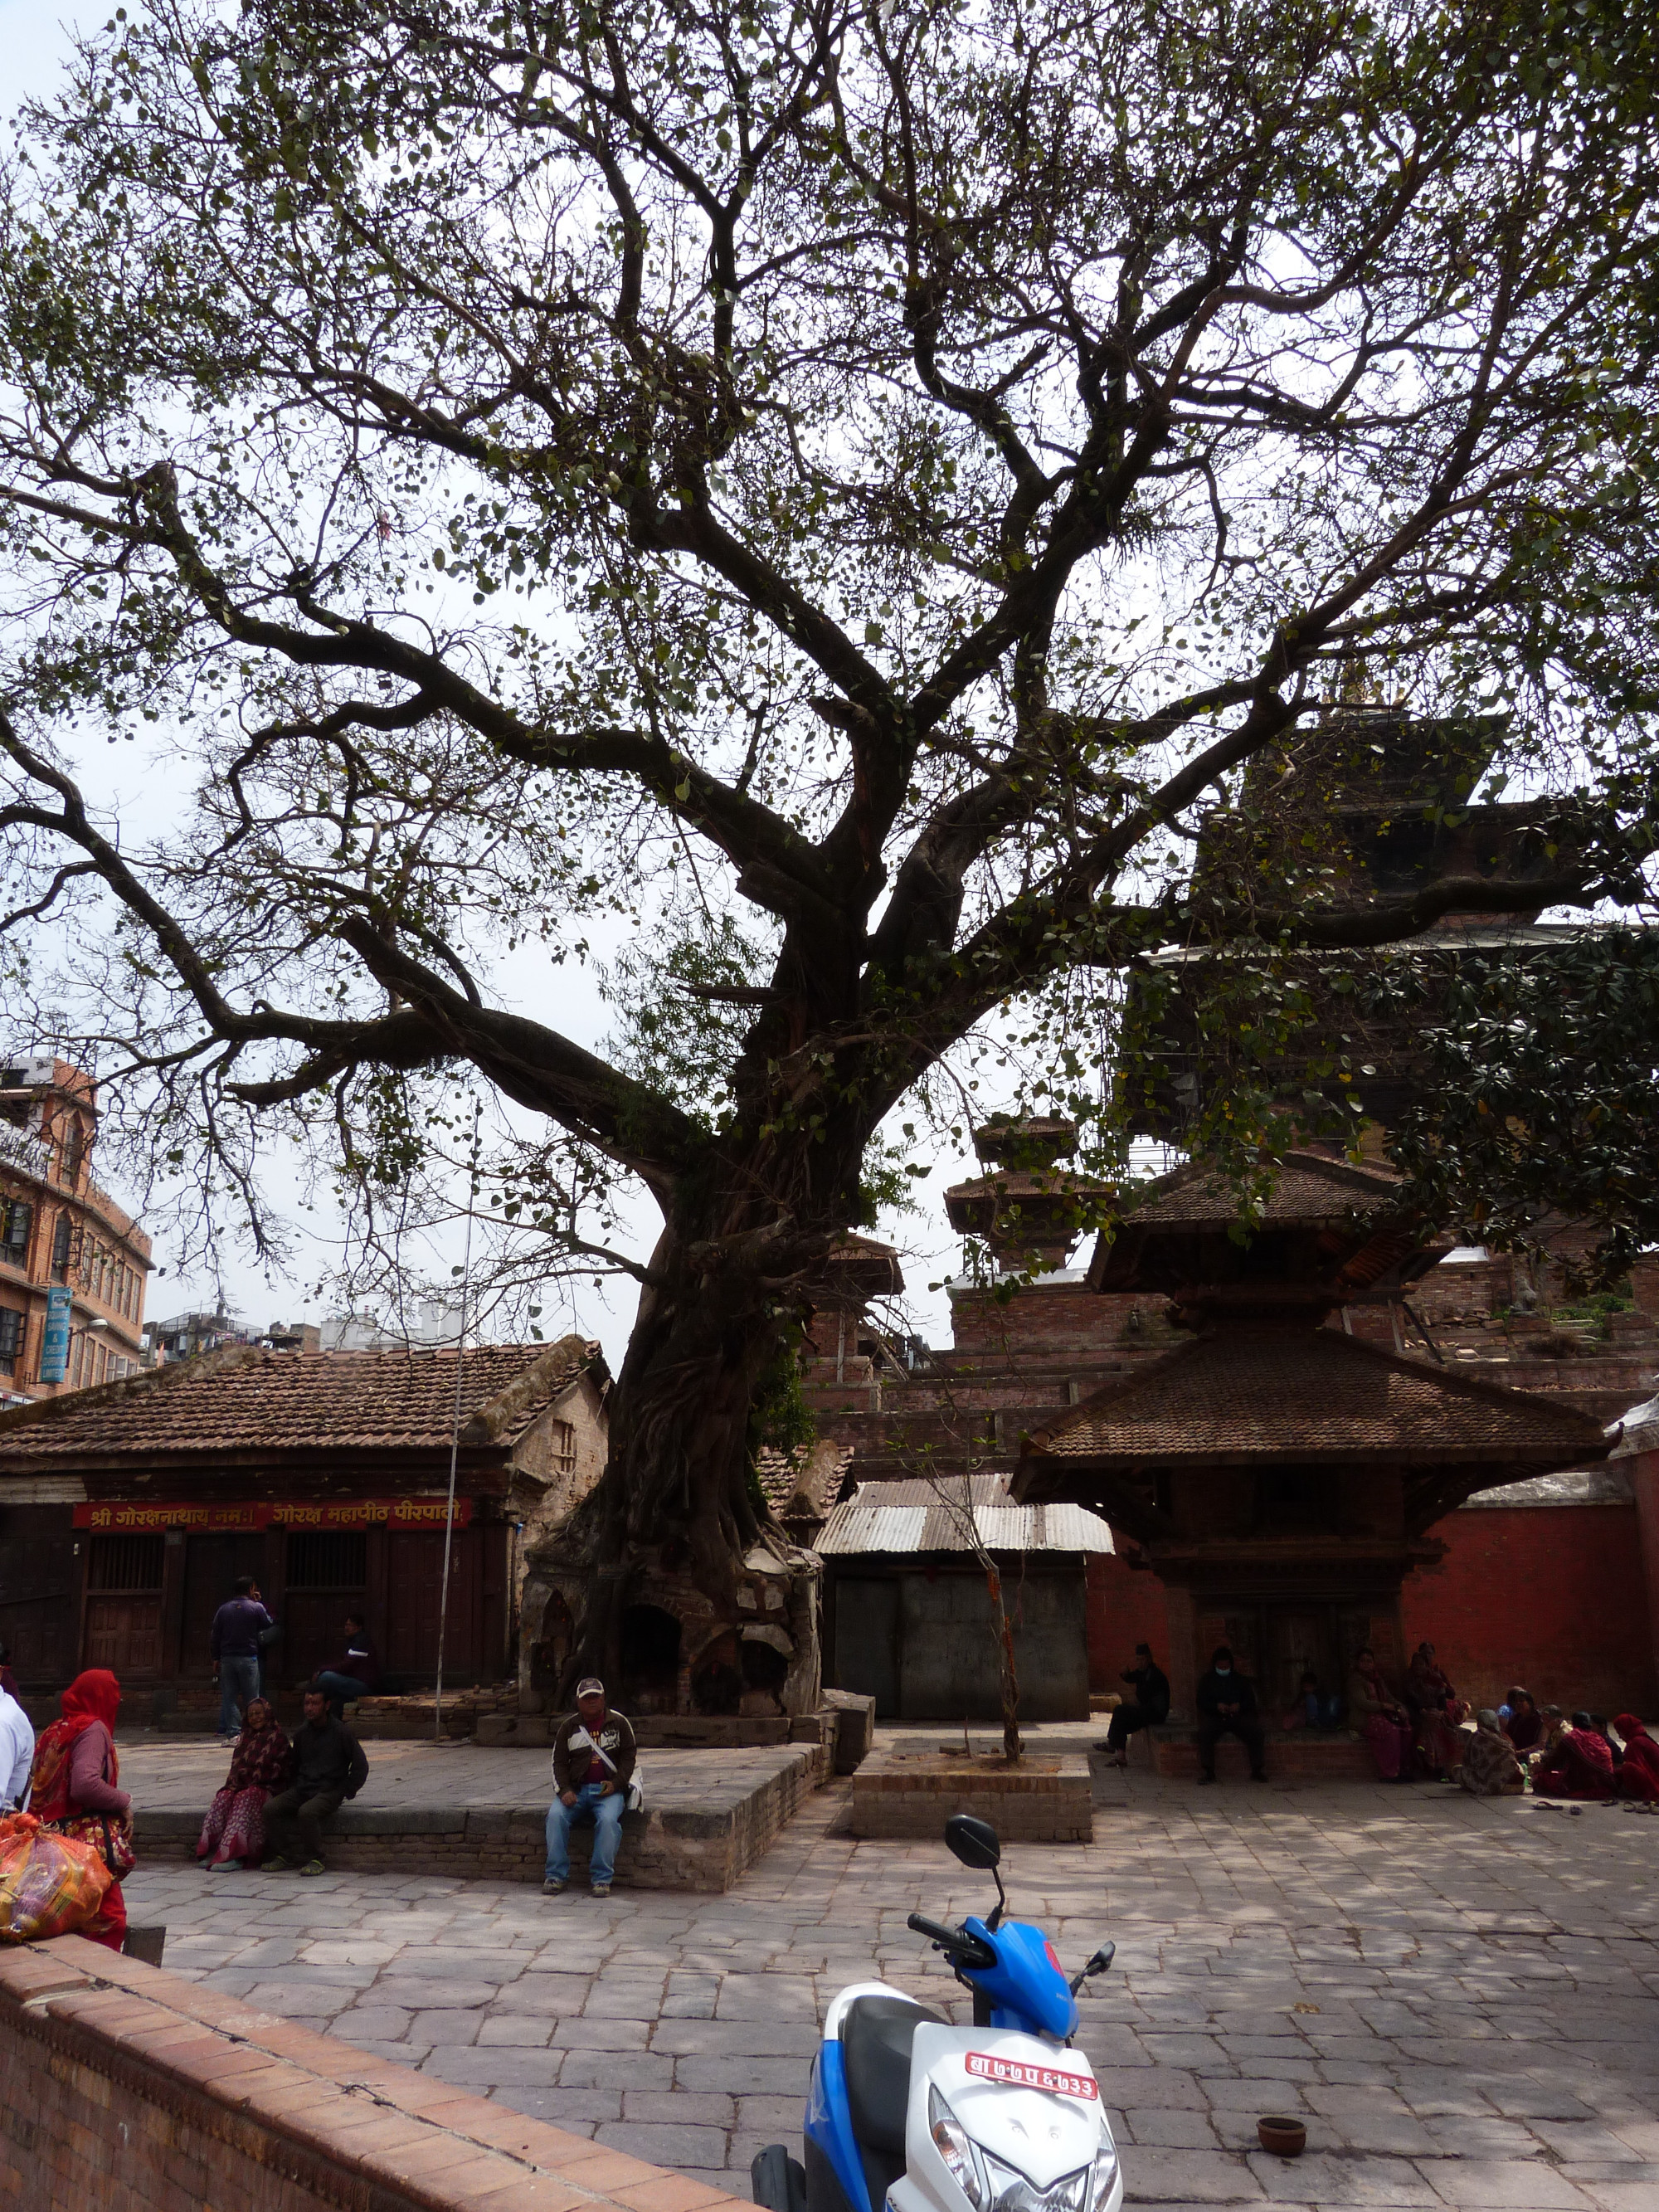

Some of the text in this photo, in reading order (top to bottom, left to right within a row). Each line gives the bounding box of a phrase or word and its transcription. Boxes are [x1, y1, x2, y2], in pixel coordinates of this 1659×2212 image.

[971, 1226, 990, 1244] बा
[47, 1322, 66, 1331] SAVING
[52, 1333, 58, 1342] &
[90, 1507, 113, 1527] श्री
[272, 1504, 324, 1526] गोरक्ष
[328, 1501, 391, 1524] महापीठ
